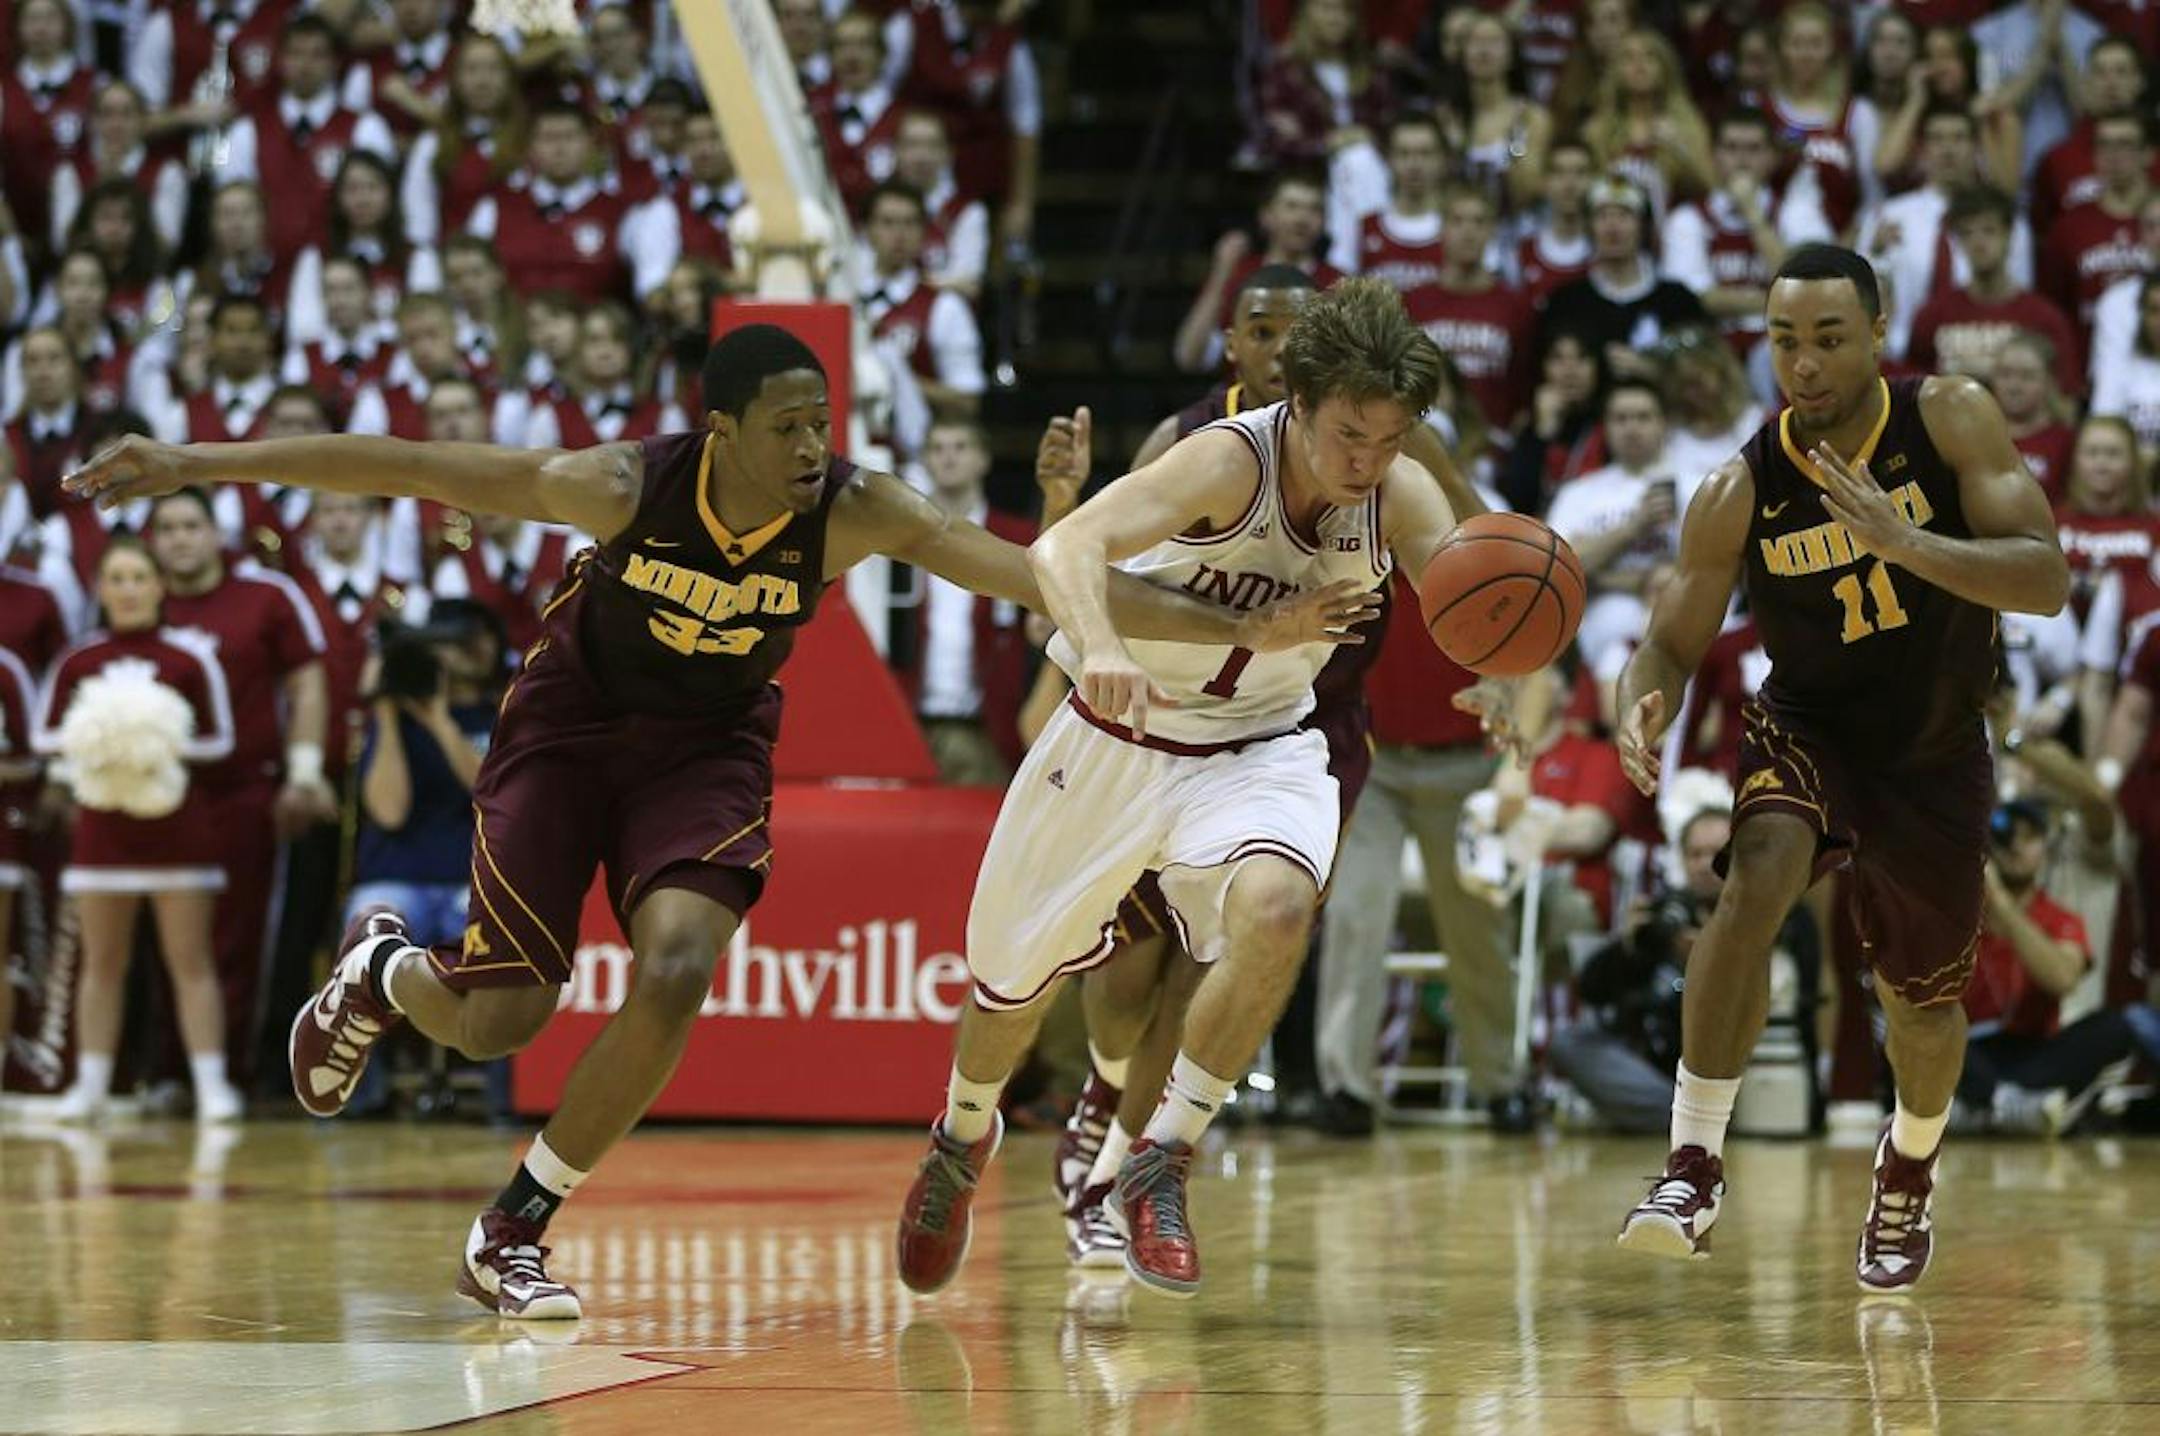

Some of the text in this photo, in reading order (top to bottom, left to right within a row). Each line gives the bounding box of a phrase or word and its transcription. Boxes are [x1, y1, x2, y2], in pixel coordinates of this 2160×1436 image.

[1760, 479, 1934, 577] MINNTA
[621, 552, 800, 622] MINNEOTA
[1182, 563, 1299, 611] INDI
[1832, 559, 1909, 645] 11
[1201, 646, 1254, 699] 1
[556, 918, 970, 1022] mhville
